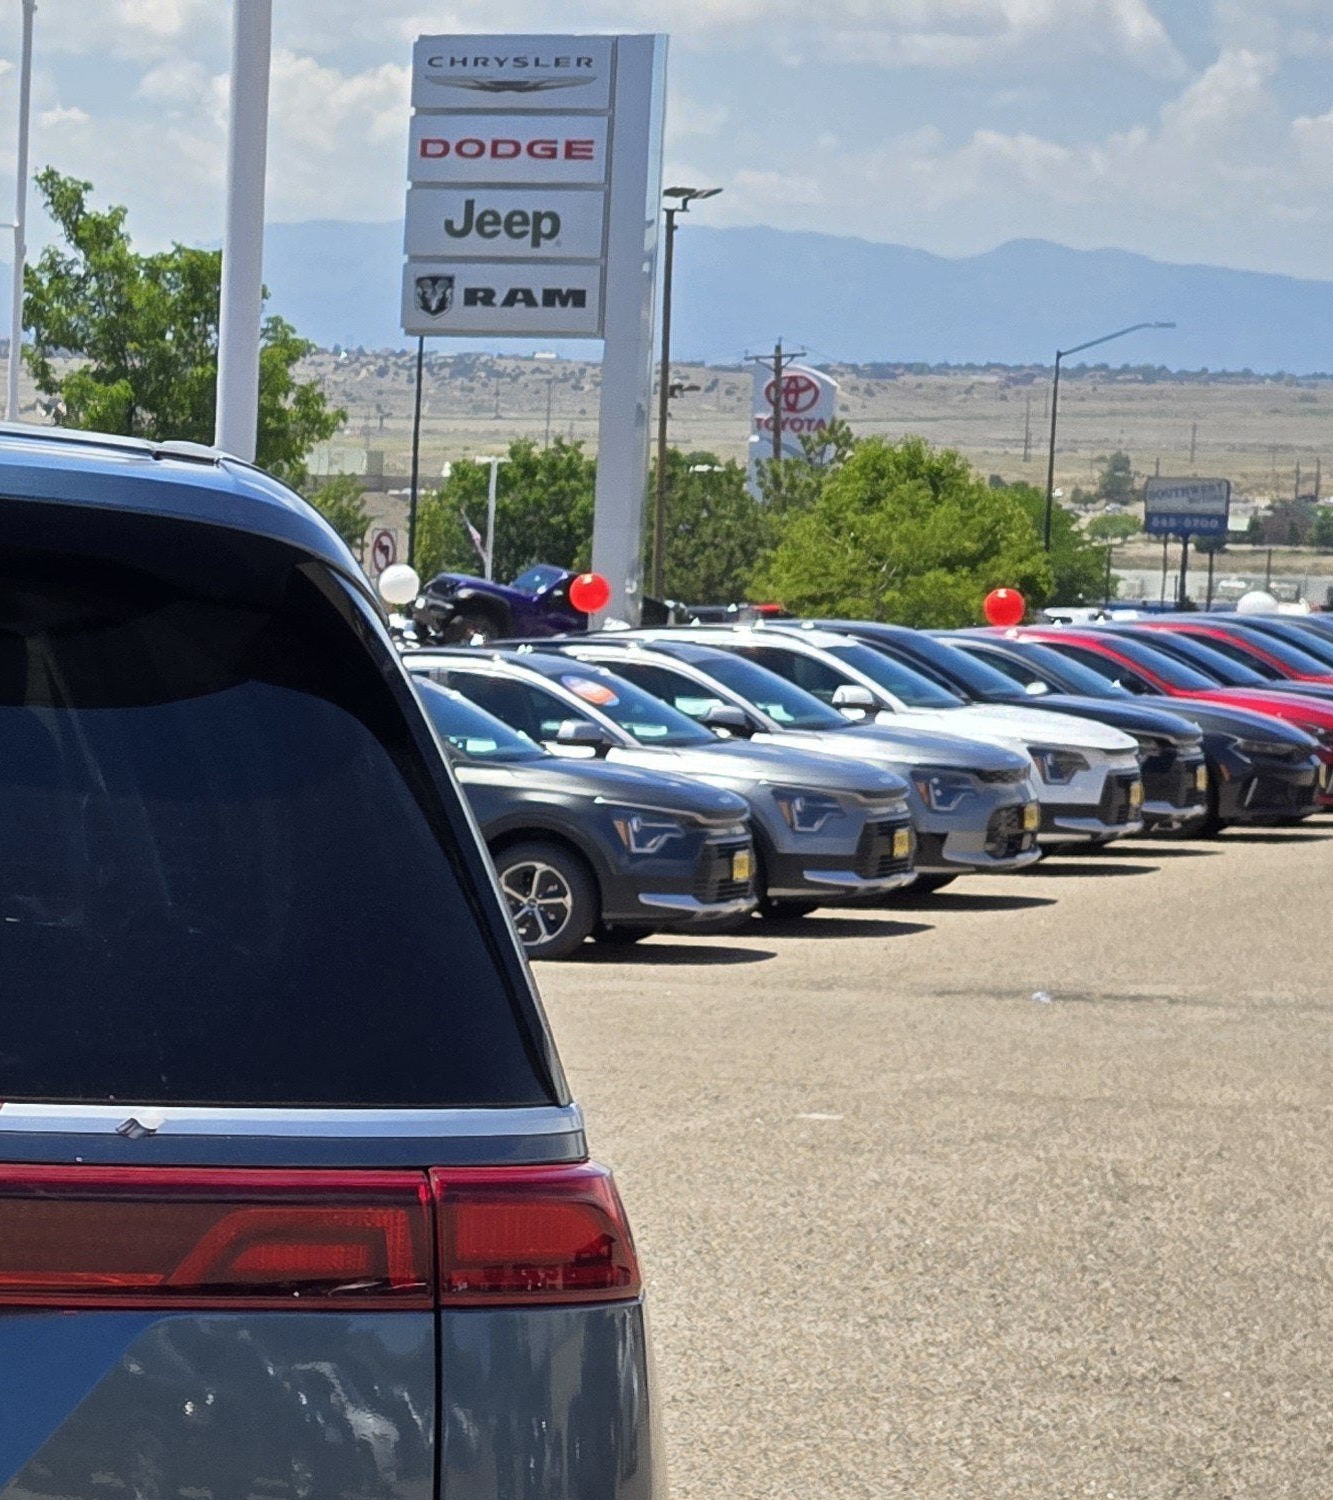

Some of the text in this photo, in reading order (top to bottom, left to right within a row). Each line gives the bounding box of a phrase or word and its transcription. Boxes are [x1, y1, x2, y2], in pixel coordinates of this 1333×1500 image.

[427, 56, 594, 69] CHRYSLER
[419, 138, 595, 161] DODGE
[444, 199, 561, 249] Jeep
[463, 287, 587, 308] RAM
